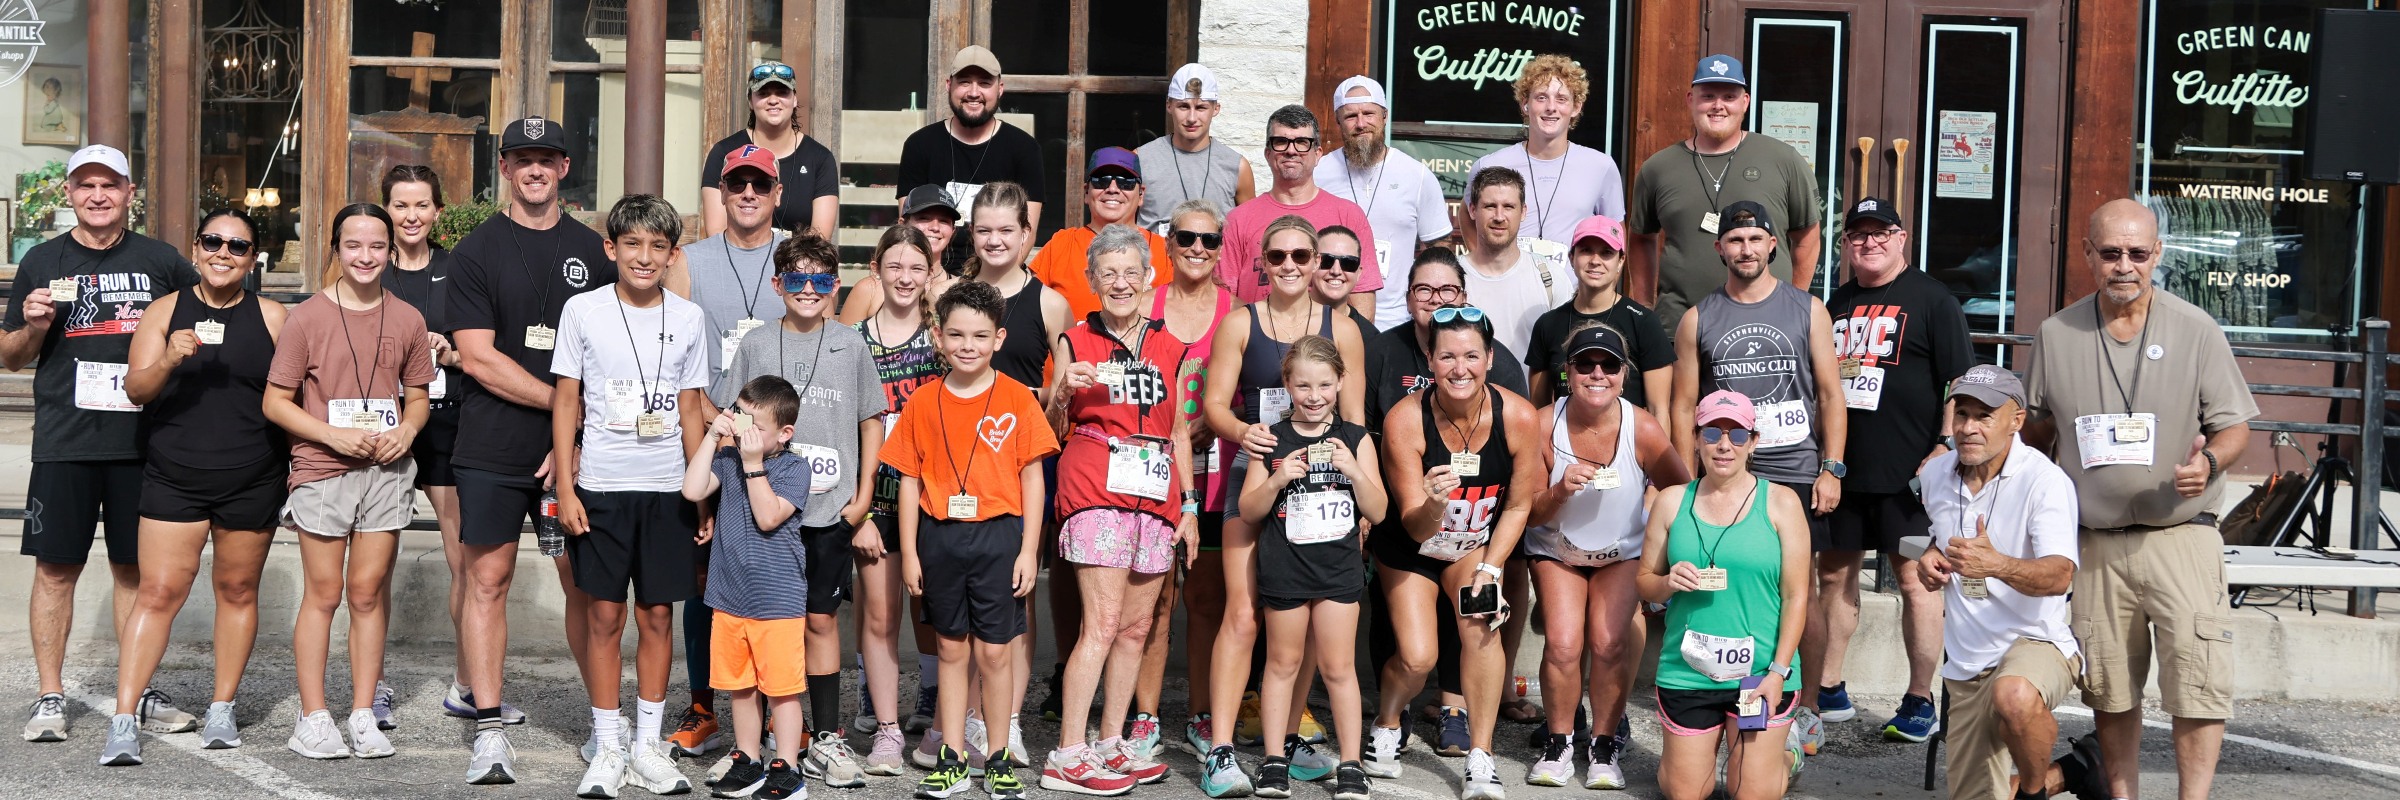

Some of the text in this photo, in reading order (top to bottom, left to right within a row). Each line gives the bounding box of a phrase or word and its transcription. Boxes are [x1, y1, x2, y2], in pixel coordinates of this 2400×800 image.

[1417, 1, 1585, 36] GREEN CANOE
[2177, 25, 2311, 55] GREEN CAN
[1413, 45, 1537, 90] Outfitt
[740, 145, 760, 158] F
[1421, 158, 1473, 173] MEN'S
[2179, 184, 2329, 203] WATERING HOLE
[99, 273, 151, 292] RUN TO
[2207, 272, 2291, 288] FLY SHOP
[102, 292, 152, 302] REMEMBER
[121, 320, 140, 331] 202
[1723, 327, 1781, 345] STEPHENVILLE
[914, 363, 932, 372] THE
[1108, 357, 1147, 371] ueled
[1712, 359, 1797, 377] RUNNING CLUB
[110, 375, 126, 391] 1
[1108, 373, 1164, 406] BEEF
[1850, 376, 1879, 392] 126
[640, 392, 676, 411] 185
[809, 386, 843, 401] GAME
[1775, 409, 1806, 427] 188
[805, 456, 837, 475] 68
[1143, 460, 1169, 480] 149
[1310, 473, 1352, 484] REMEMBE
[1317, 500, 1352, 520] 173
[1442, 496, 1498, 532] RC
[1584, 548, 1619, 560] 106
[1691, 632, 1701, 641] RUN
[1702, 635, 1708, 643] TO
[1714, 648, 1751, 664] 108
